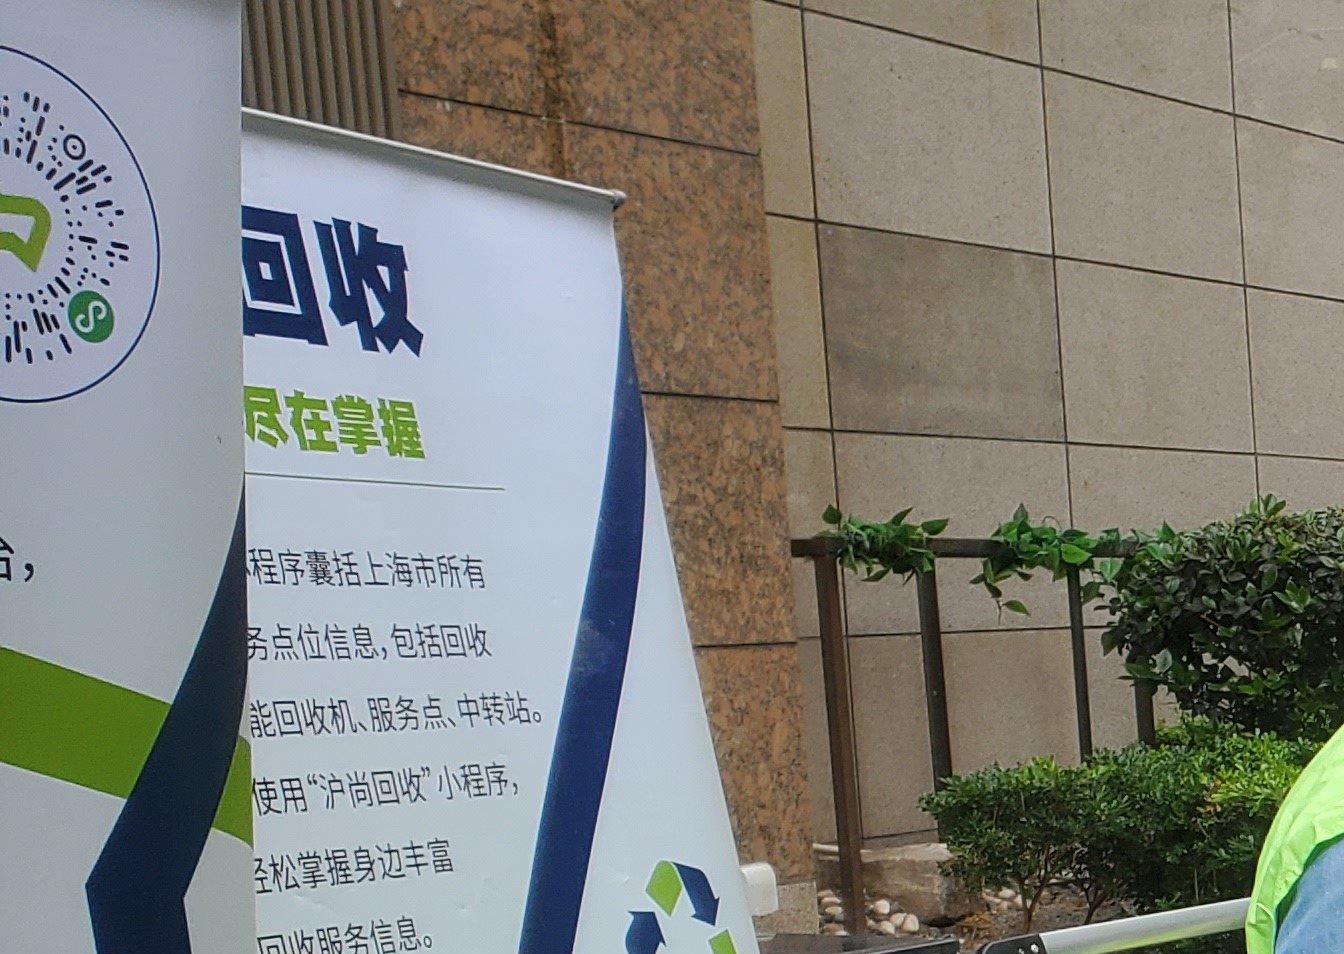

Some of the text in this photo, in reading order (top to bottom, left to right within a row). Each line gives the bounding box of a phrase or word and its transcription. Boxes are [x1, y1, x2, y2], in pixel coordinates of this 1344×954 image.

[241, 205, 424, 358] 回收
[243, 385, 425, 460] 尽在掌握
[246, 548, 486, 590] 程序囊括上海市所有
[250, 691, 542, 739] 能回收机、服务点、中转站。
